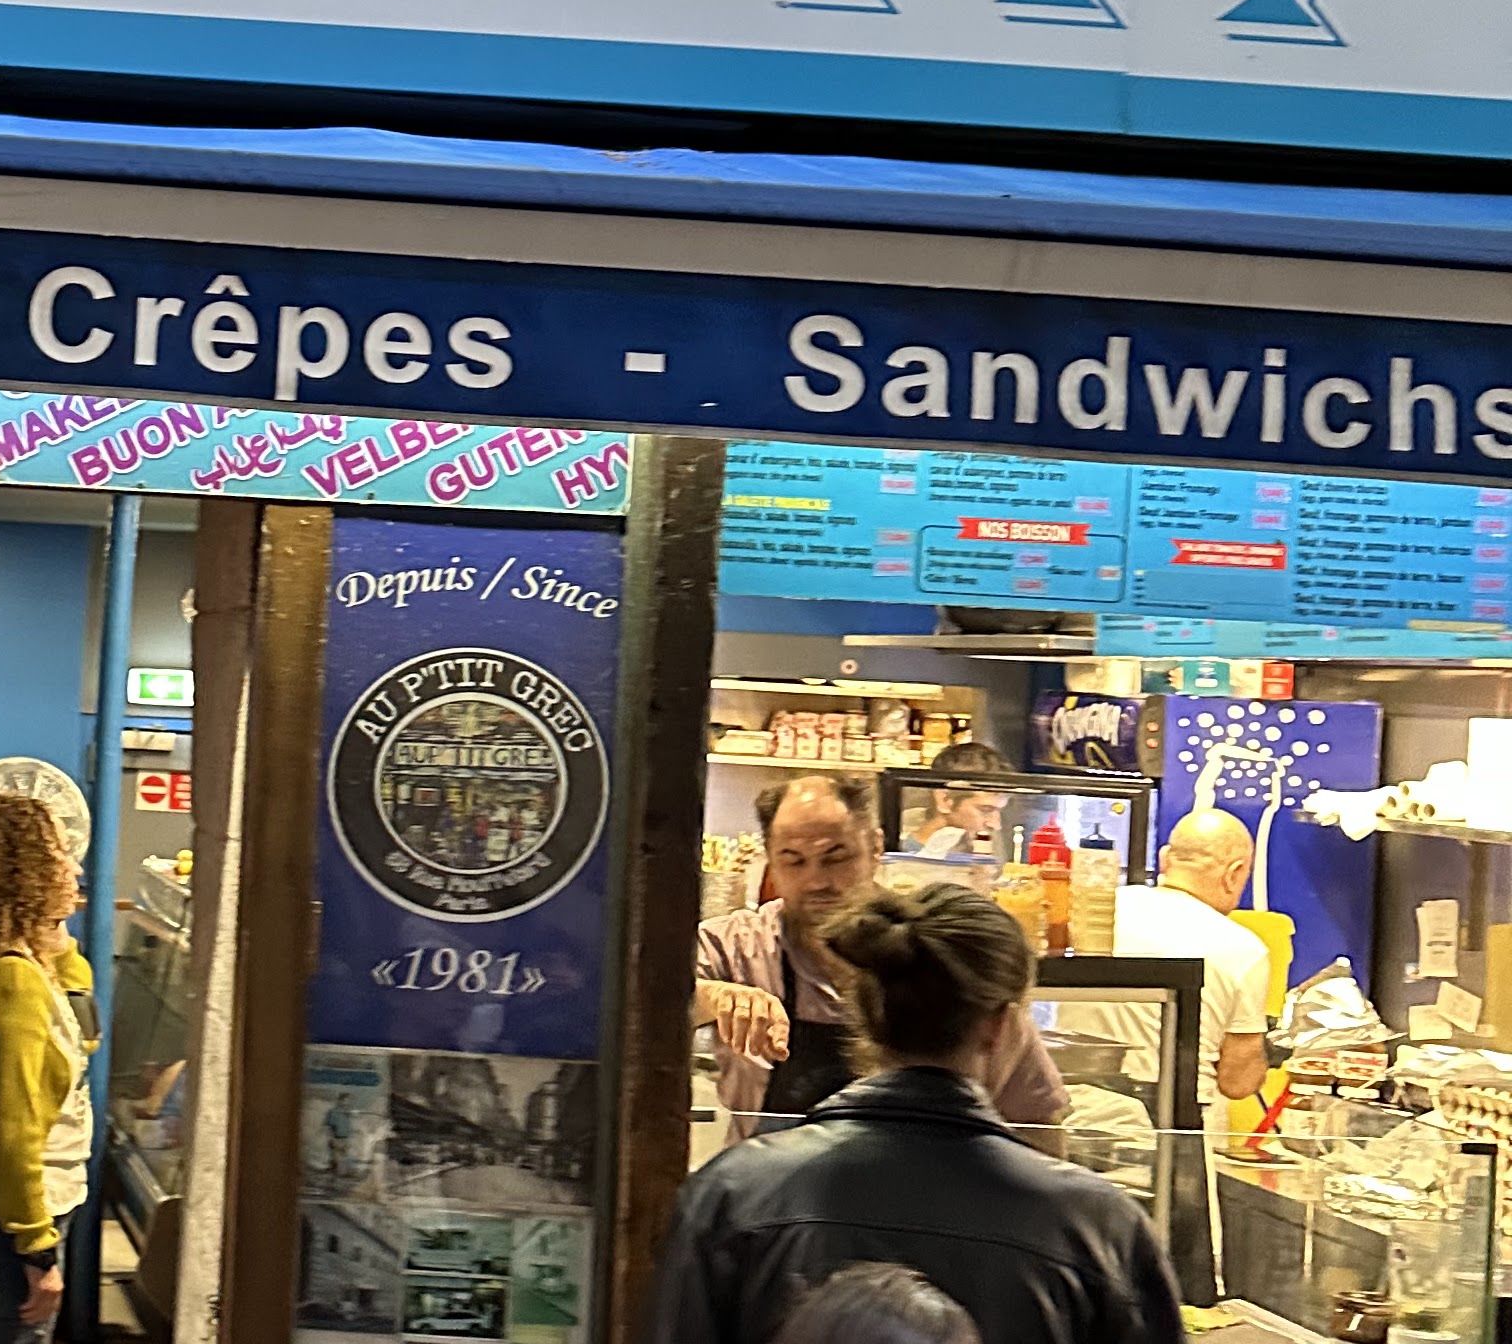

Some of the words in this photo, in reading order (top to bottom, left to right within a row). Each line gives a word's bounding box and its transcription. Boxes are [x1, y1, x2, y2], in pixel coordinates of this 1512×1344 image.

[28, 266, 514, 401] Crêpes
[783, 313, 1512, 457] Sandwichs
[71, 403, 204, 486] BUON
[335, 556, 477, 609] Depuis
[511, 564, 620, 619] Since
[355, 694, 398, 745] AU
[399, 657, 505, 704] P'TIT
[510, 669, 595, 754] GREC
[370, 946, 548, 996] «1981»
